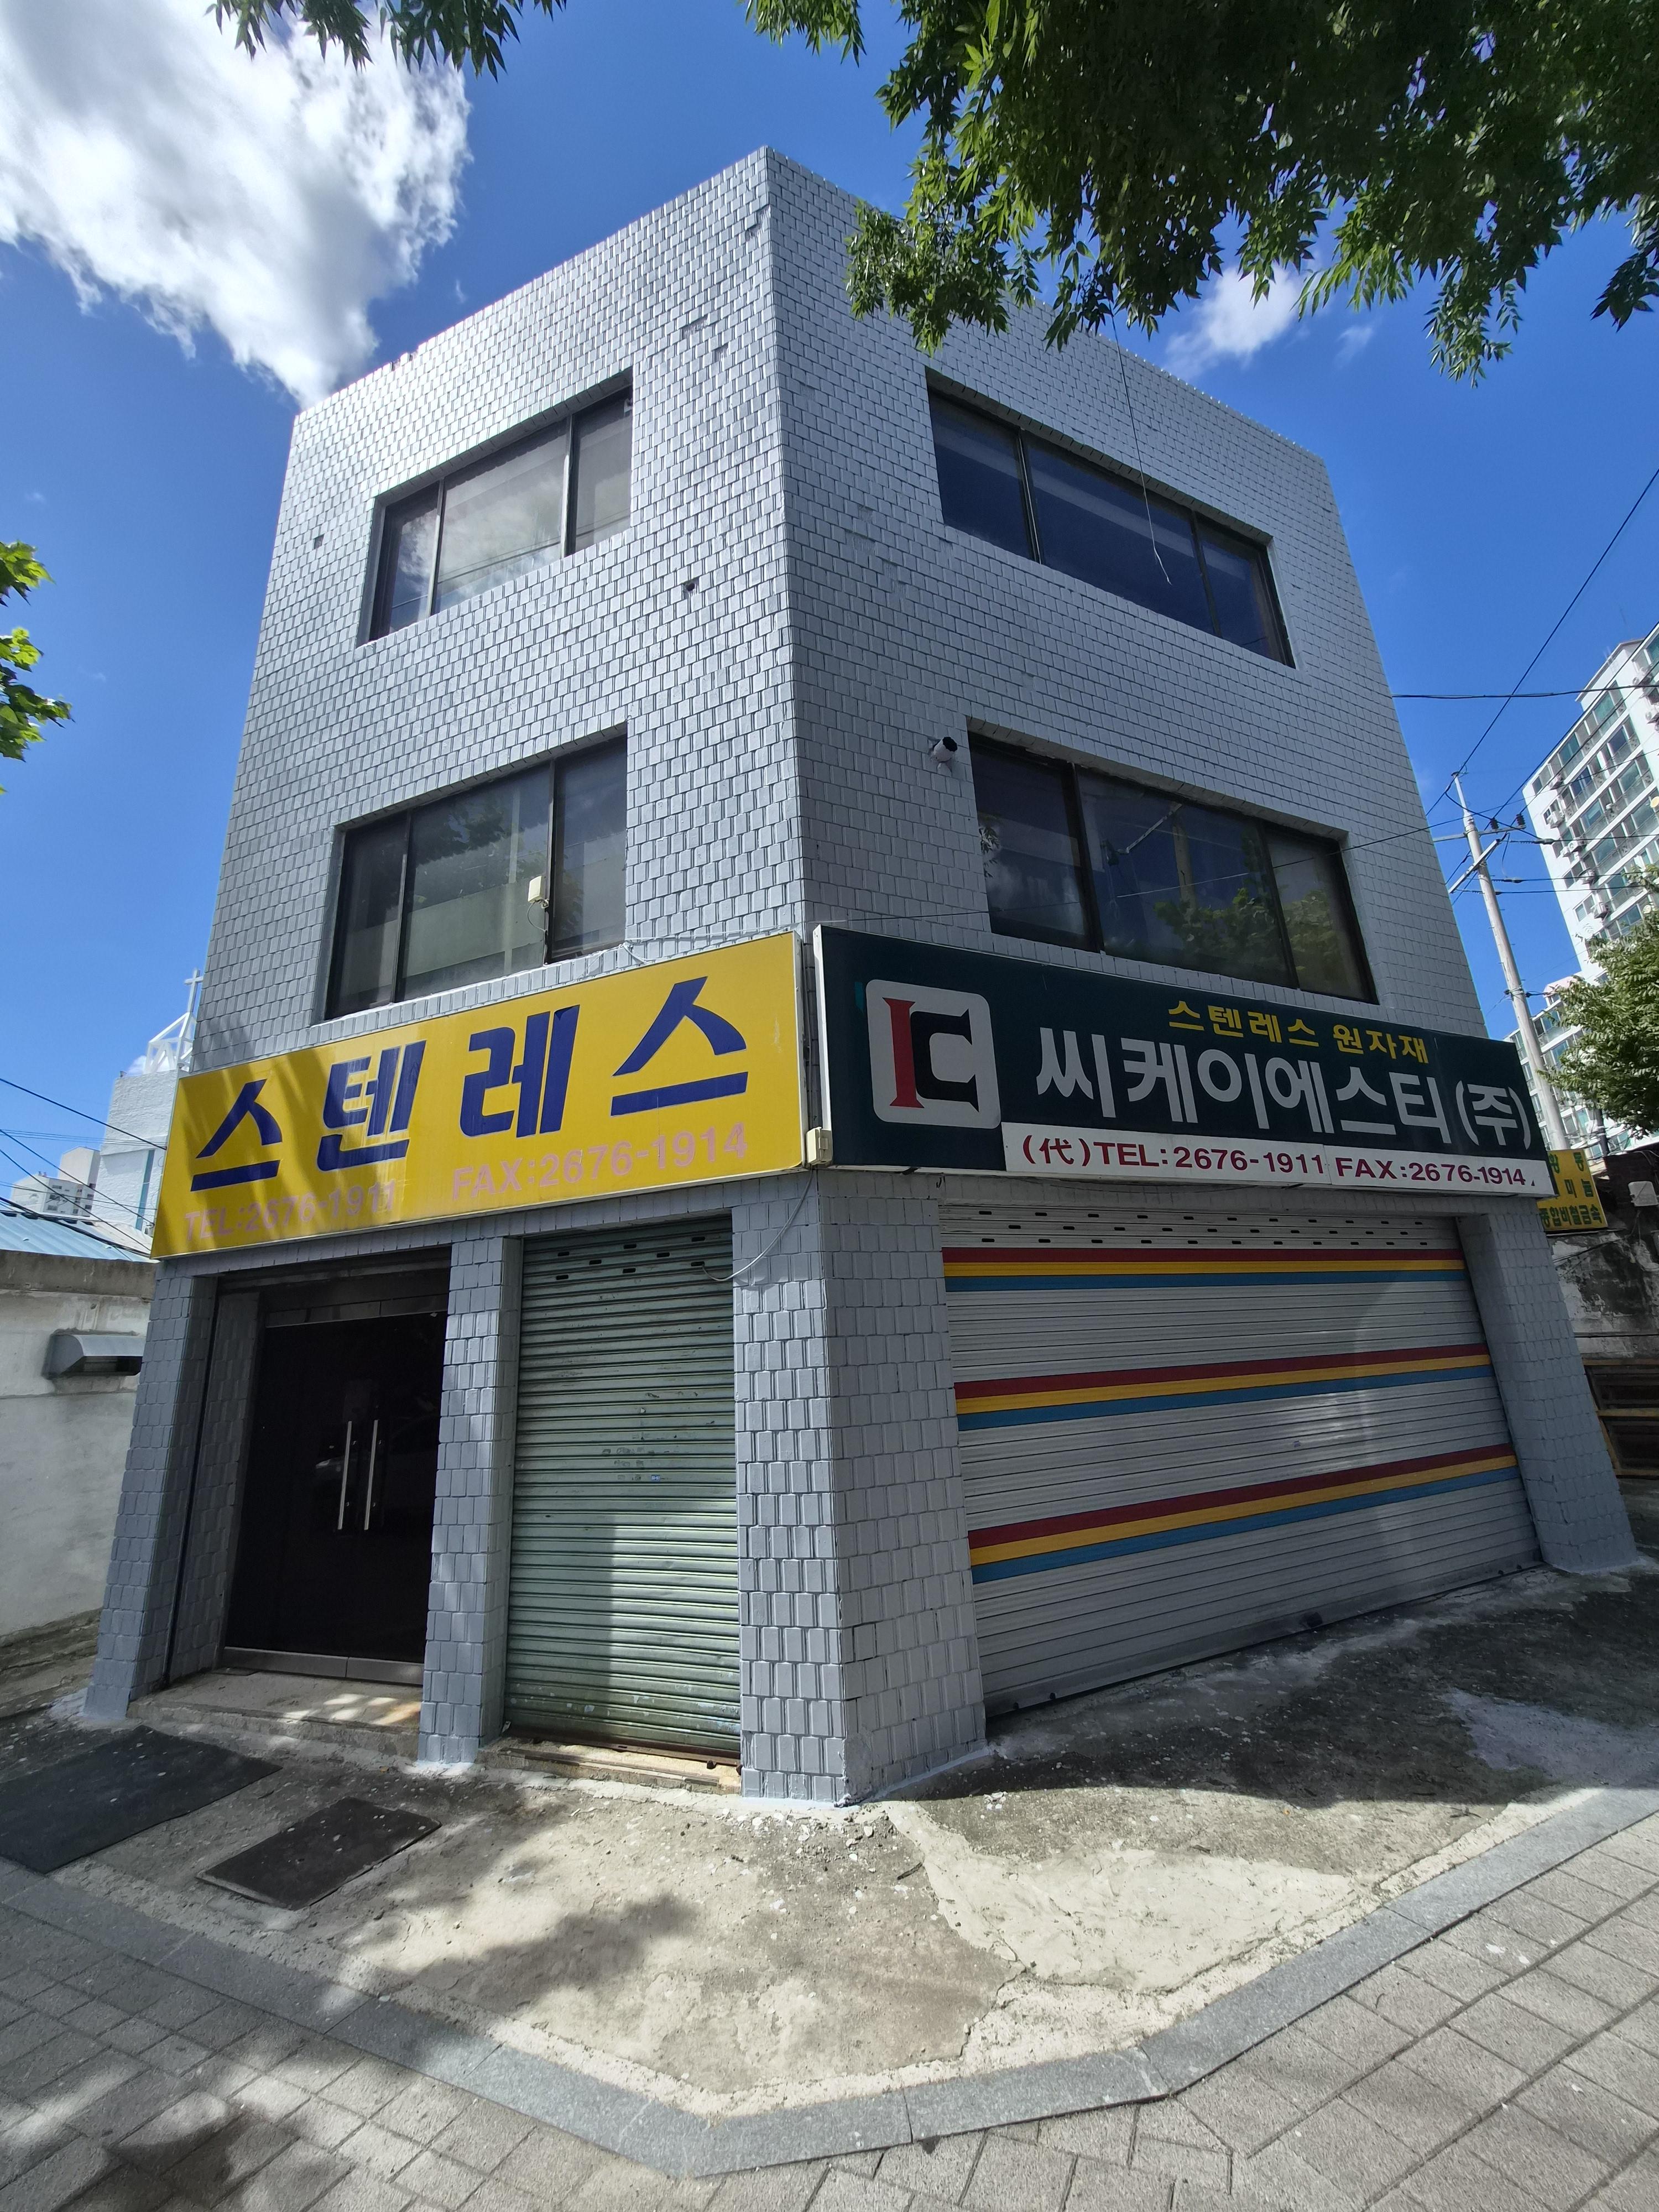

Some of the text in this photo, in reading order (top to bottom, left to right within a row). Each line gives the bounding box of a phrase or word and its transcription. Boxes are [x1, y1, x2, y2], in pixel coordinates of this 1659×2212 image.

[1168, 1000, 1430, 1064] 스텐레스 원자재
[190, 975, 748, 1192] 스텐레스
[184, 1121, 748, 1241] TEL:2676-1911 FAX:2676-1914
[1334, 1156, 1526, 1186] FAX:2676-1914
